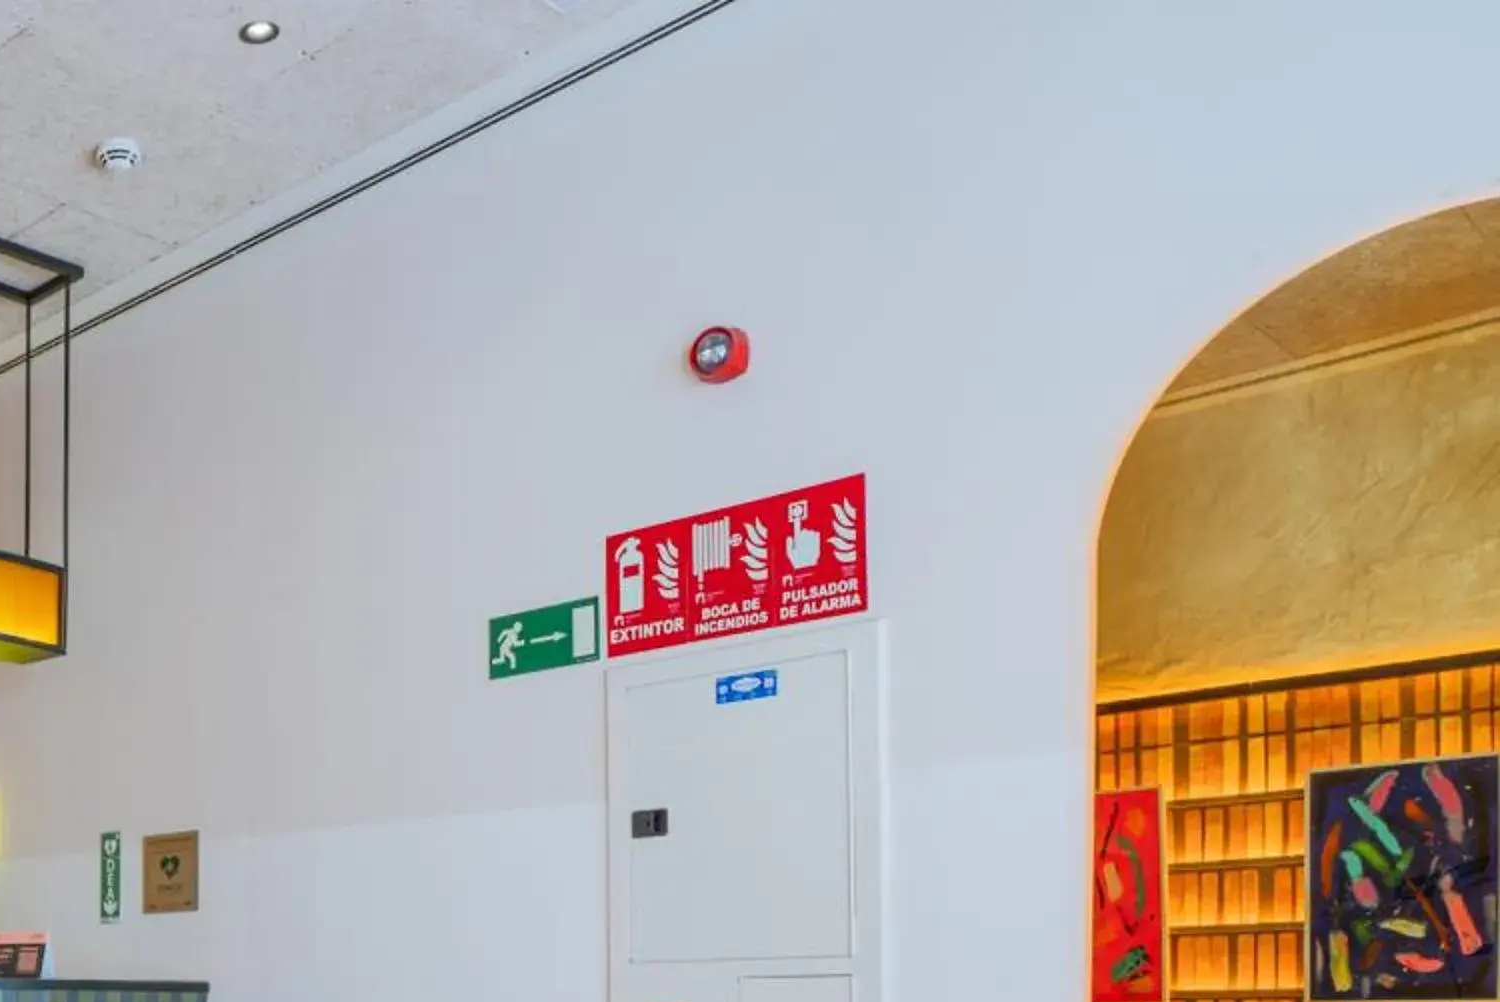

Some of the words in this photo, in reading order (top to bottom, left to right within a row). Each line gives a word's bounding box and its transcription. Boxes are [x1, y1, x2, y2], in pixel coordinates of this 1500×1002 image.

[782, 577, 859, 604] PULSADOR
[701, 603, 739, 621] BOCA
[742, 597, 761, 612] DE
[779, 605, 798, 620] DE
[801, 593, 862, 616] ALARMA
[610, 617, 685, 644] EXTINTOR
[695, 611, 768, 636] INCENDIOS
